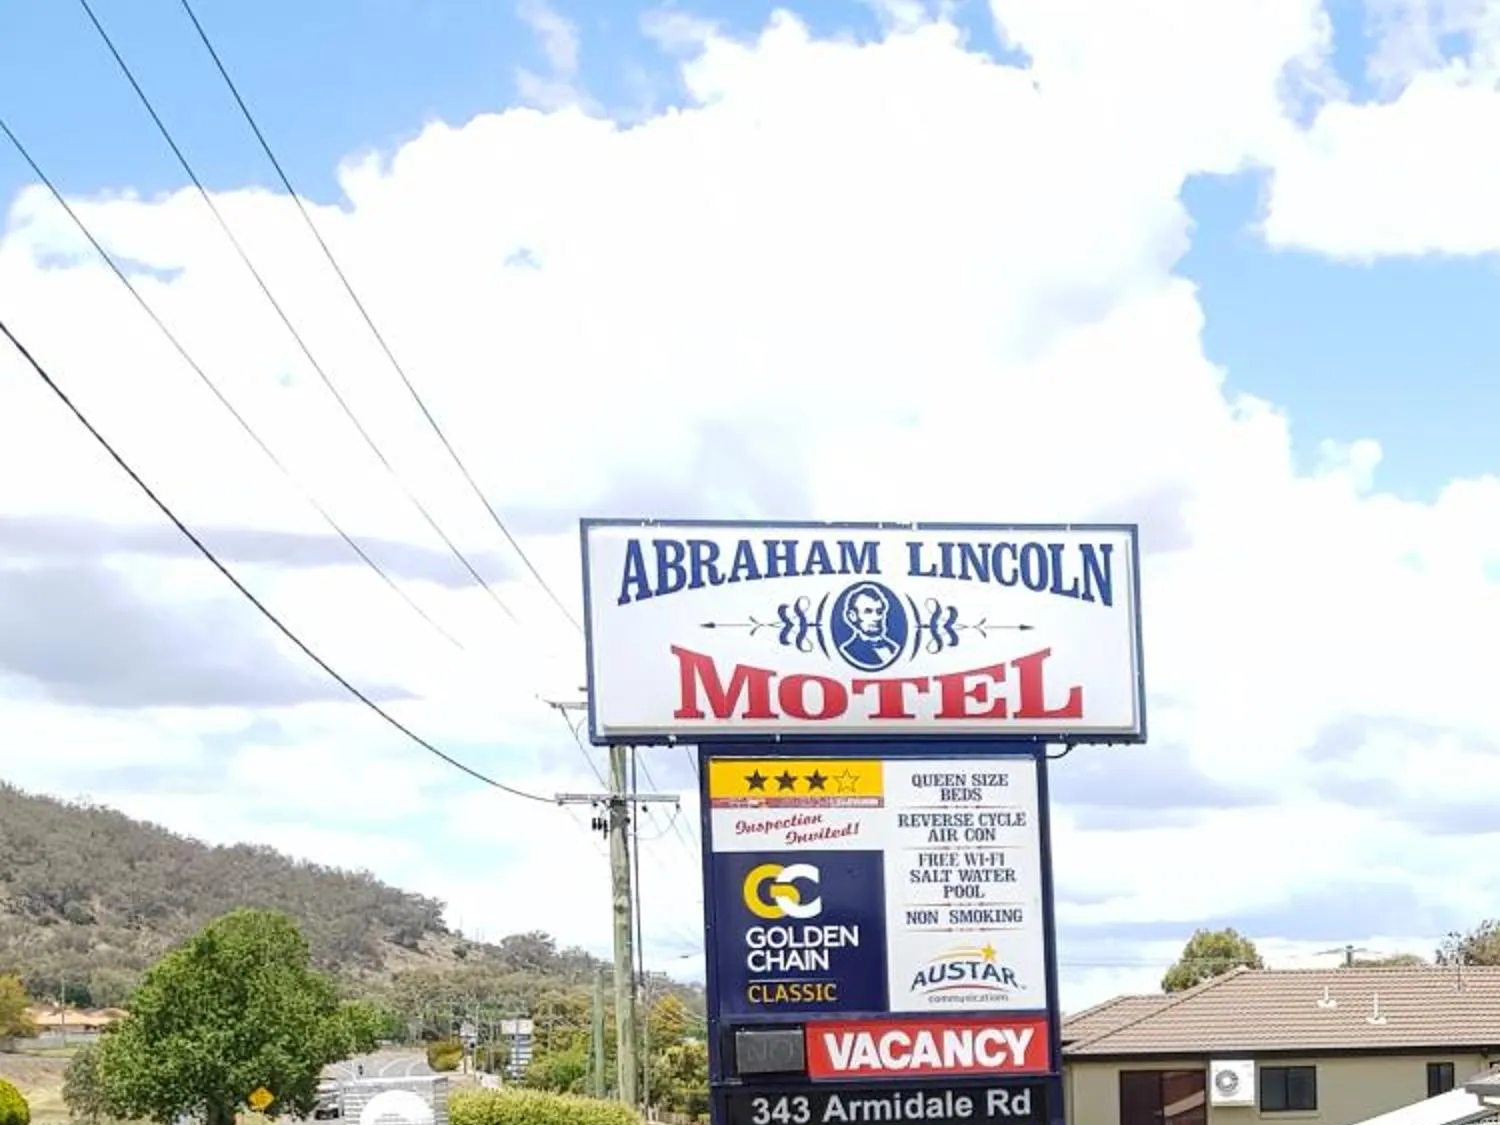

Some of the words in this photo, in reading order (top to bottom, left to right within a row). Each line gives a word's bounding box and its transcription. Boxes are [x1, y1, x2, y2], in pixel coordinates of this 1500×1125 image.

[617, 538, 882, 606] ABRAHAM
[905, 541, 1114, 607] LINCOLN
[670, 644, 1084, 720] MOTEL
[911, 774, 967, 788] QUEEN
[971, 773, 1009, 787] SIZE
[940, 788, 983, 802] BEDS
[735, 813, 823, 834] Inspection
[897, 813, 974, 828] REVERSE
[978, 812, 1027, 827] CYCLE
[785, 821, 861, 845] Invited!
[928, 829, 960, 843] AIR
[964, 828, 996, 842] CON
[918, 853, 960, 867] FREE
[964, 852, 1005, 866] WI-FI
[910, 869, 954, 883] SALT
[958, 868, 1016, 883] WATER
[943, 884, 985, 899] POOL
[906, 910, 939, 925] NON
[949, 909, 1023, 924] SMOKING
[745, 925, 859, 949] GOLDEN
[747, 950, 830, 973] CHAIN
[910, 961, 1019, 992] AUSTAR
[748, 983, 838, 1004] CLASSIC
[823, 1027, 1035, 1071] VACANCY
[752, 1097, 811, 1125] 343
[822, 1090, 973, 1123] Armidale
[986, 1088, 1031, 1117] Rd
